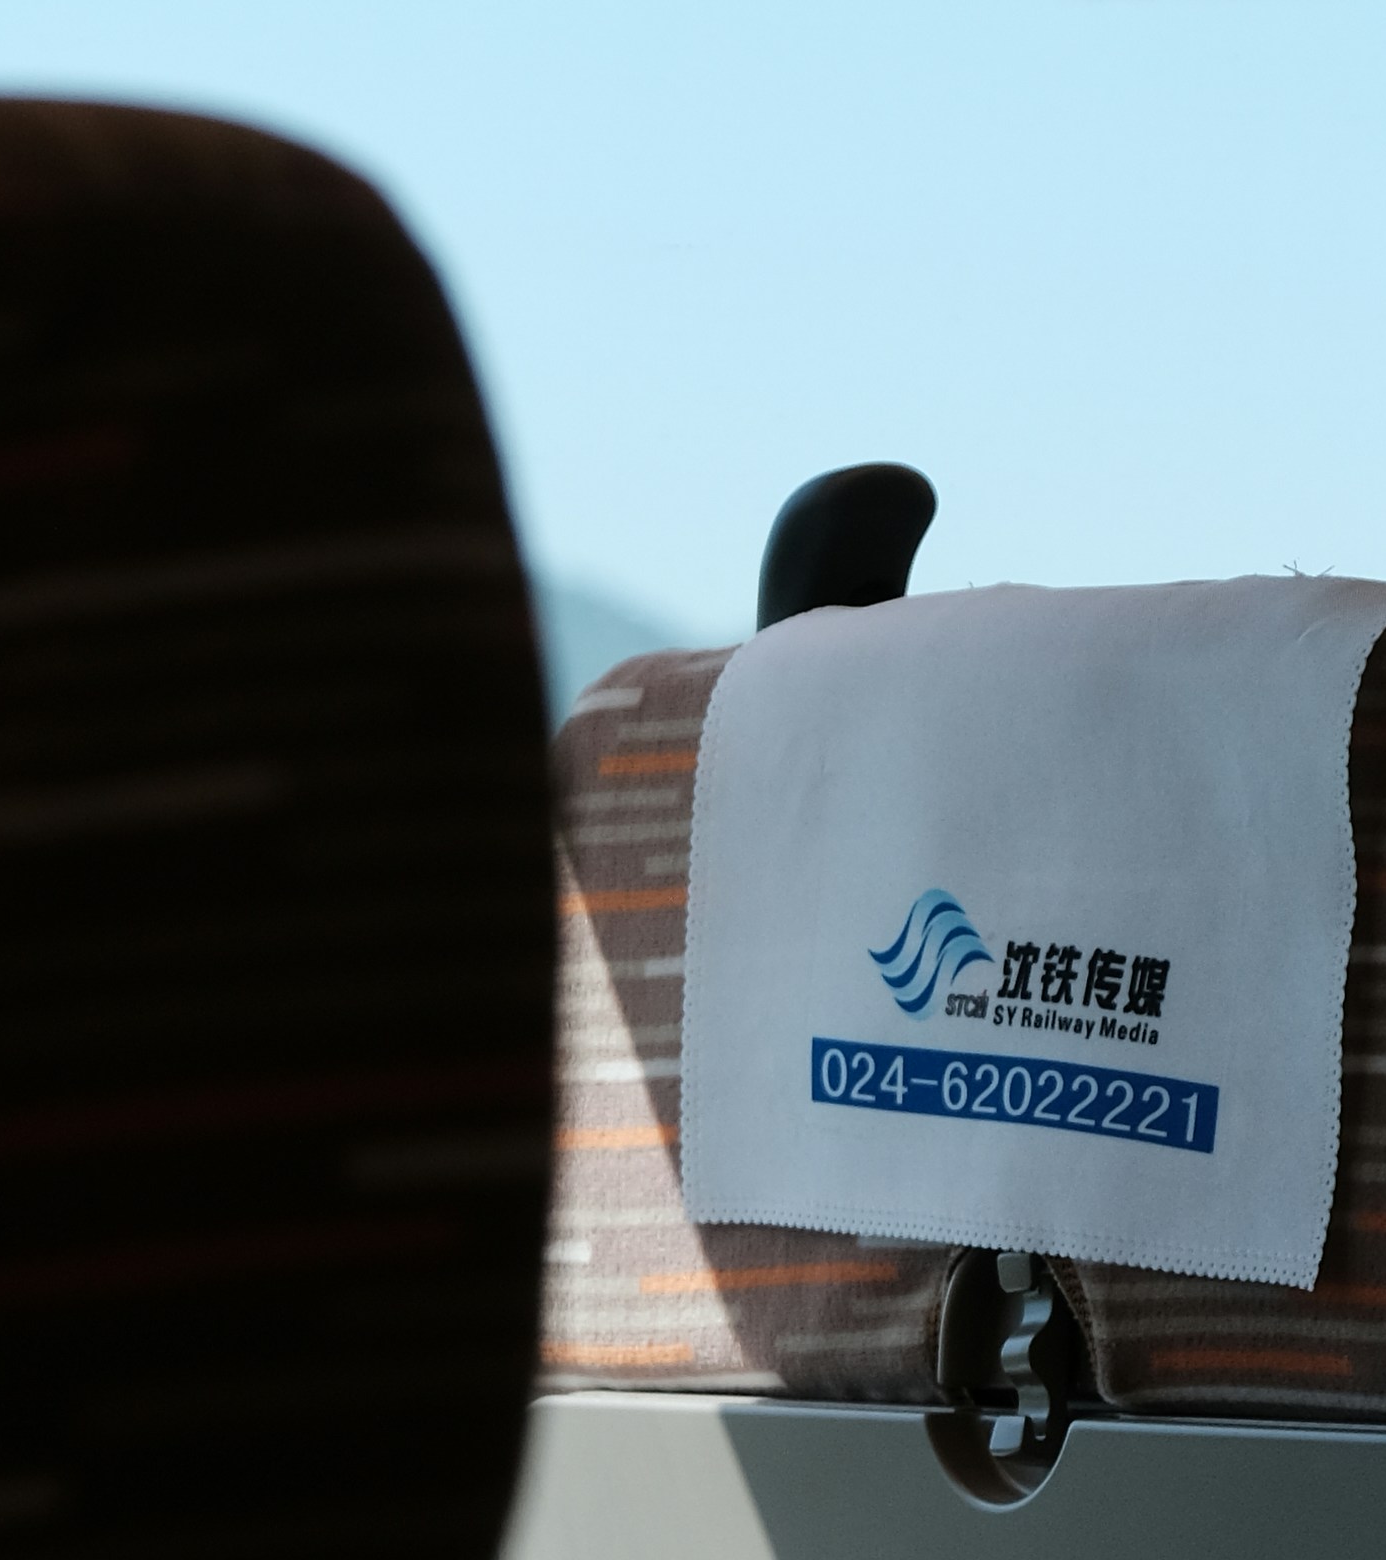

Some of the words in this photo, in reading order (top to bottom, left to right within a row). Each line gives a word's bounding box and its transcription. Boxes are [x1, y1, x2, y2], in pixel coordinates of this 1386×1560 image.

[997, 940, 1170, 1017] 沈铁传媒
[993, 1004, 1018, 1026] SY
[1021, 1007, 1095, 1040] Railway
[1099, 1016, 1159, 1045] Media
[820, 1047, 1200, 1143] 024-62022221
